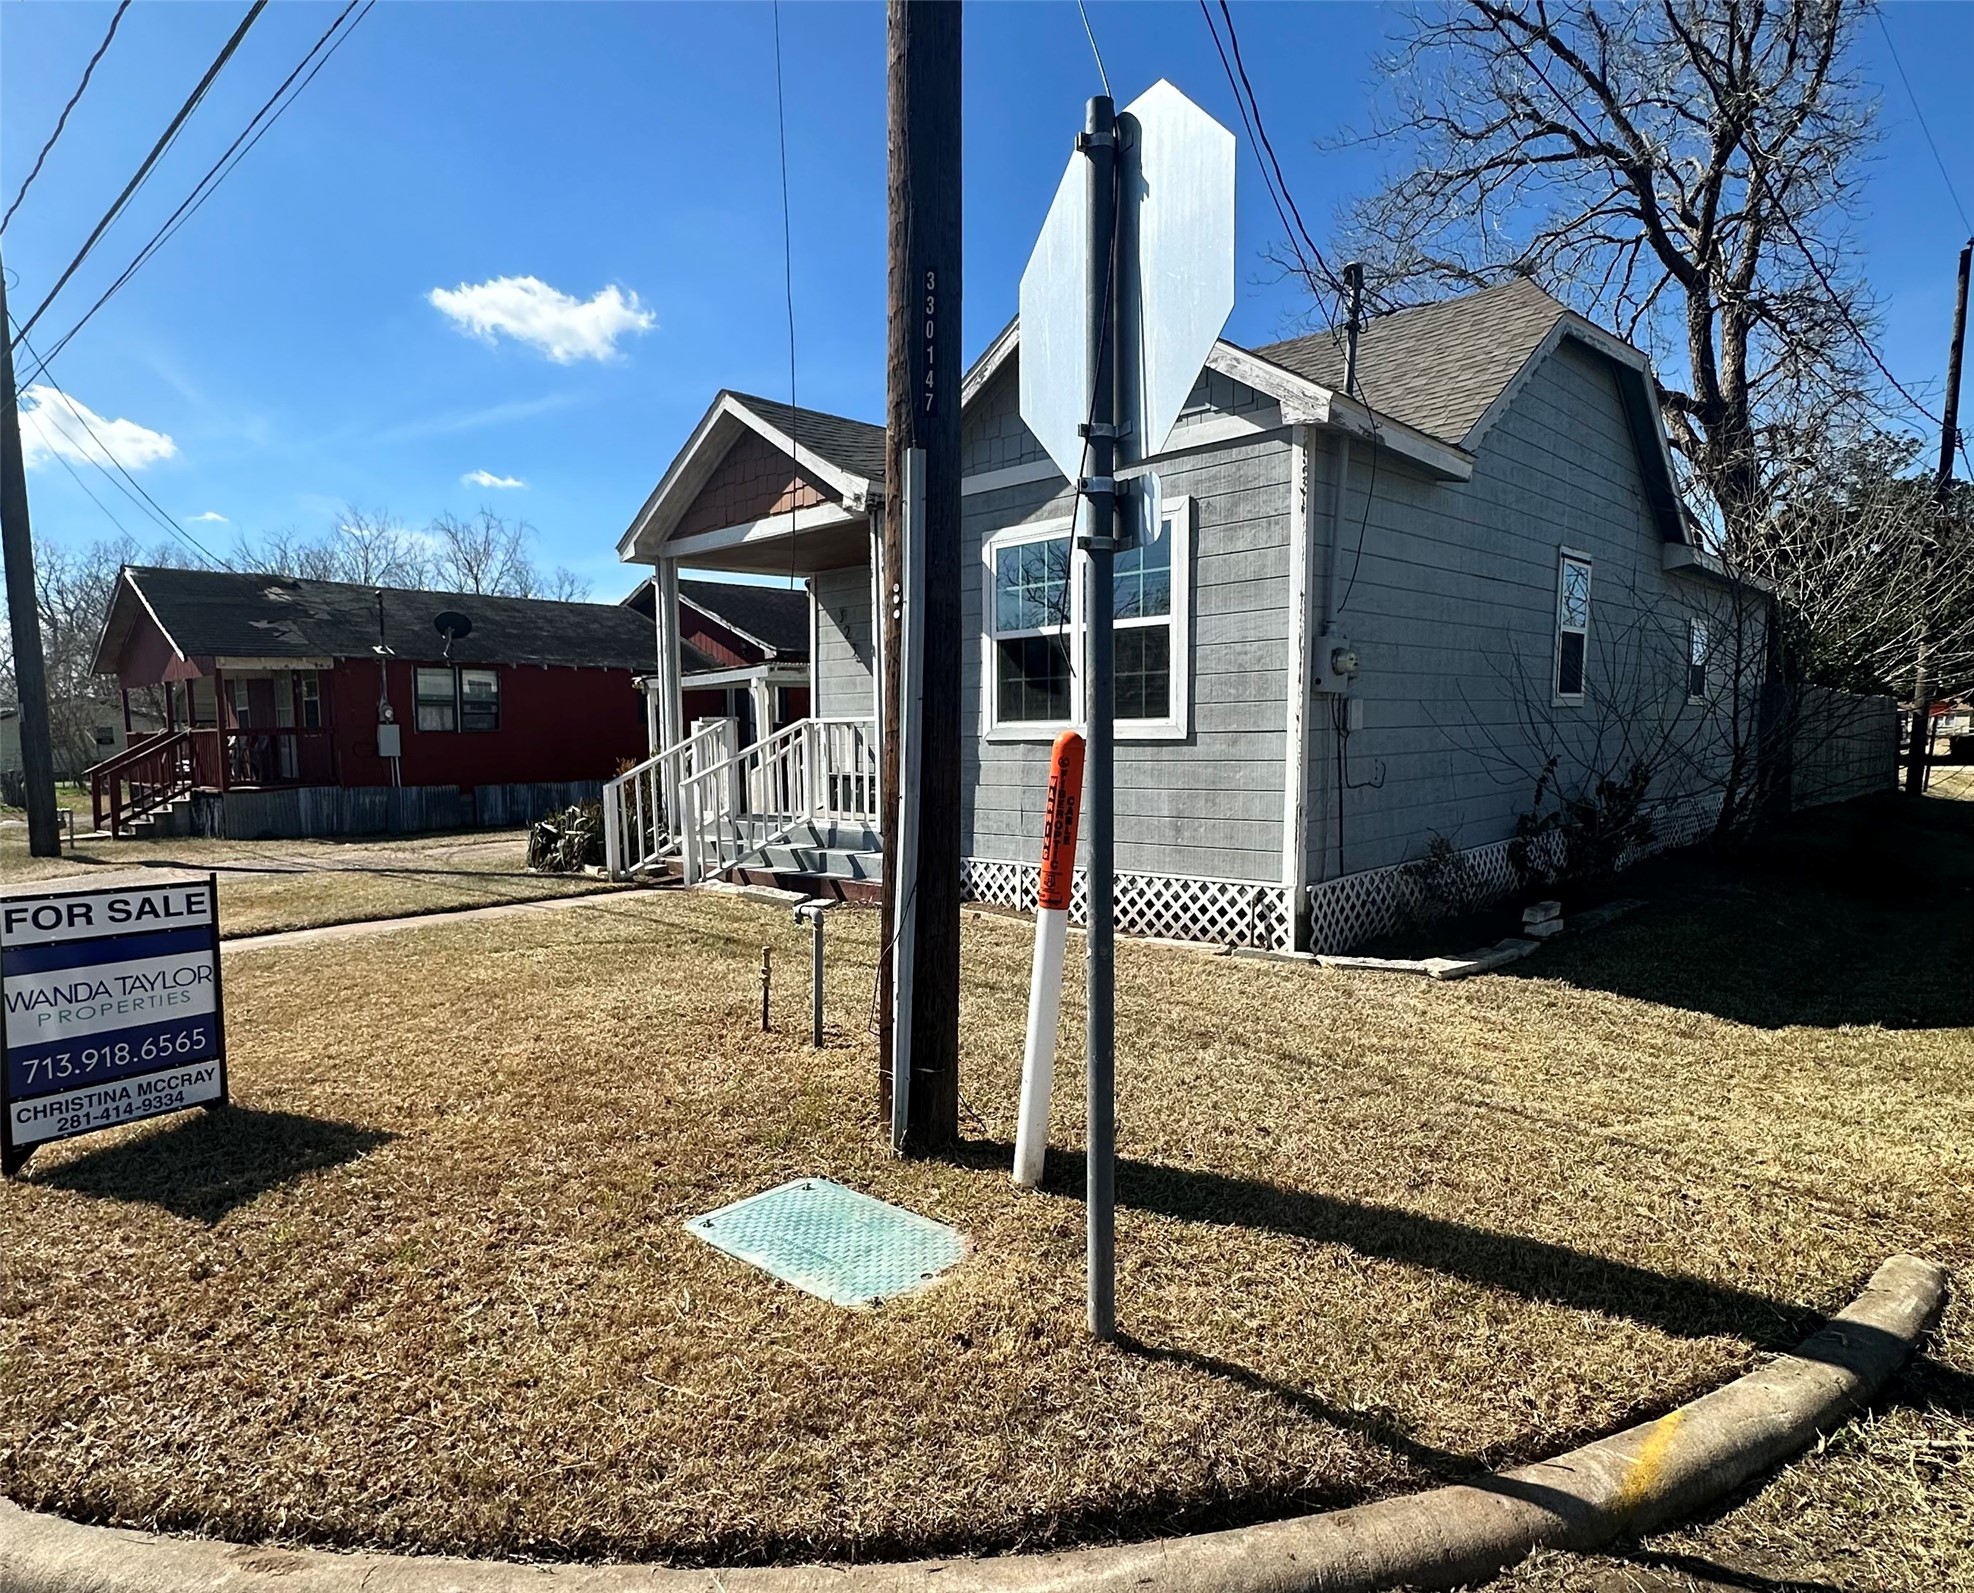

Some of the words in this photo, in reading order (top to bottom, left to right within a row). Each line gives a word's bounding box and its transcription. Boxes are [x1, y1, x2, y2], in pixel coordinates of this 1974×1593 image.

[925, 271, 935, 411] 330147
[1042, 775, 1057, 860] WARNING
[1056, 769, 1069, 819] FIBER
[1063, 796, 1074, 845] CABLE
[1050, 821, 1063, 870] OPTIC
[4, 902, 94, 934] FOR
[107, 892, 207, 923] SALE
[4, 979, 113, 1013] WANDA
[114, 964, 213, 996] TAYLOR
[38, 990, 191, 1027] PROPERTIES
[22, 1027, 206, 1084] 713.918.6565
[16, 1086, 130, 1124] CHRISTINA
[137, 1067, 216, 1098] MCCRAY
[57, 1090, 185, 1132] 281-414-9334
